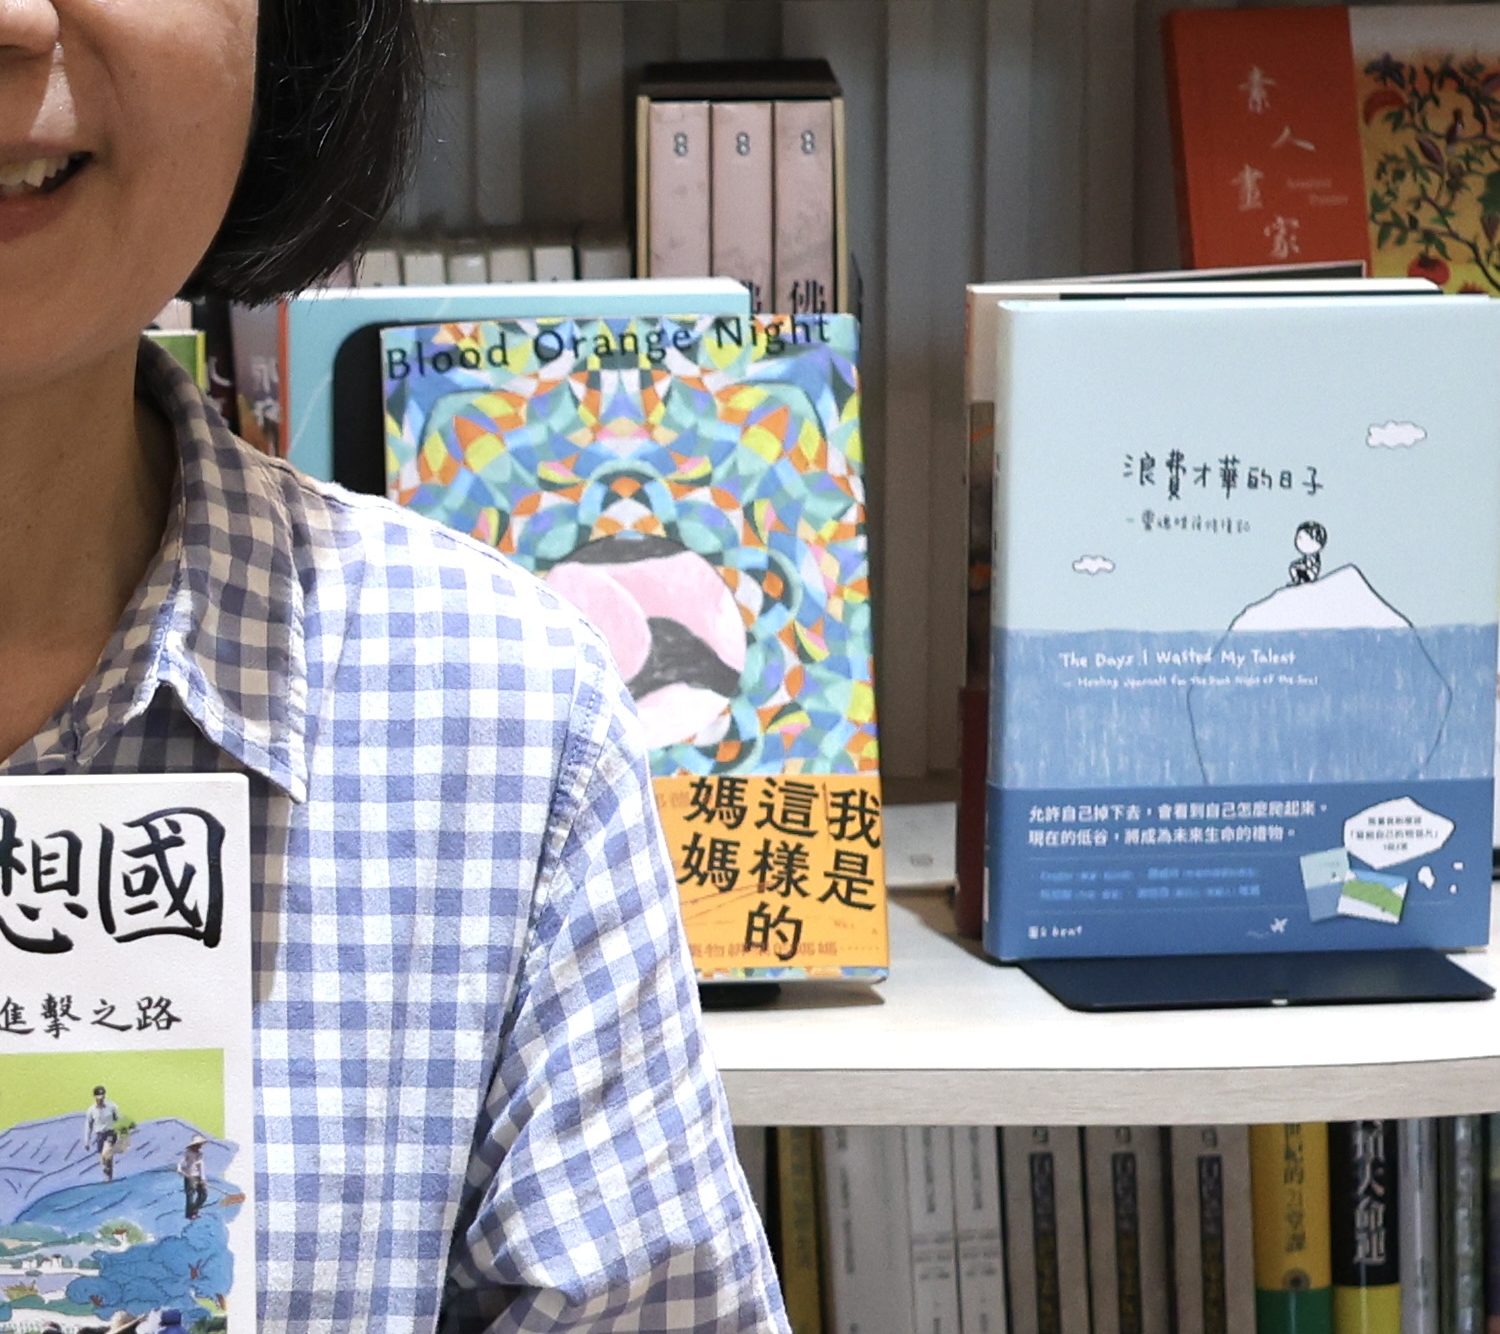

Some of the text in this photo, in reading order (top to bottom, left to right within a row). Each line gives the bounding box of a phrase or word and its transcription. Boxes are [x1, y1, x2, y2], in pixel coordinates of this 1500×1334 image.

[388, 312, 830, 380] Blood Orange Night
[1122, 449, 1324, 500] 浪費才華的日子
[1059, 652, 1088, 668] The
[1095, 652, 1134, 670] Days
[1156, 648, 1212, 666] Wasted
[1221, 648, 1246, 667] My
[1250, 647, 1297, 666] Talent
[677, 777, 748, 893] 媽媽
[817, 788, 881, 911] 我是
[1029, 826, 1296, 847] 現在的低谷，將成為未來生命的禮物。
[744, 777, 819, 962] 這樣的
